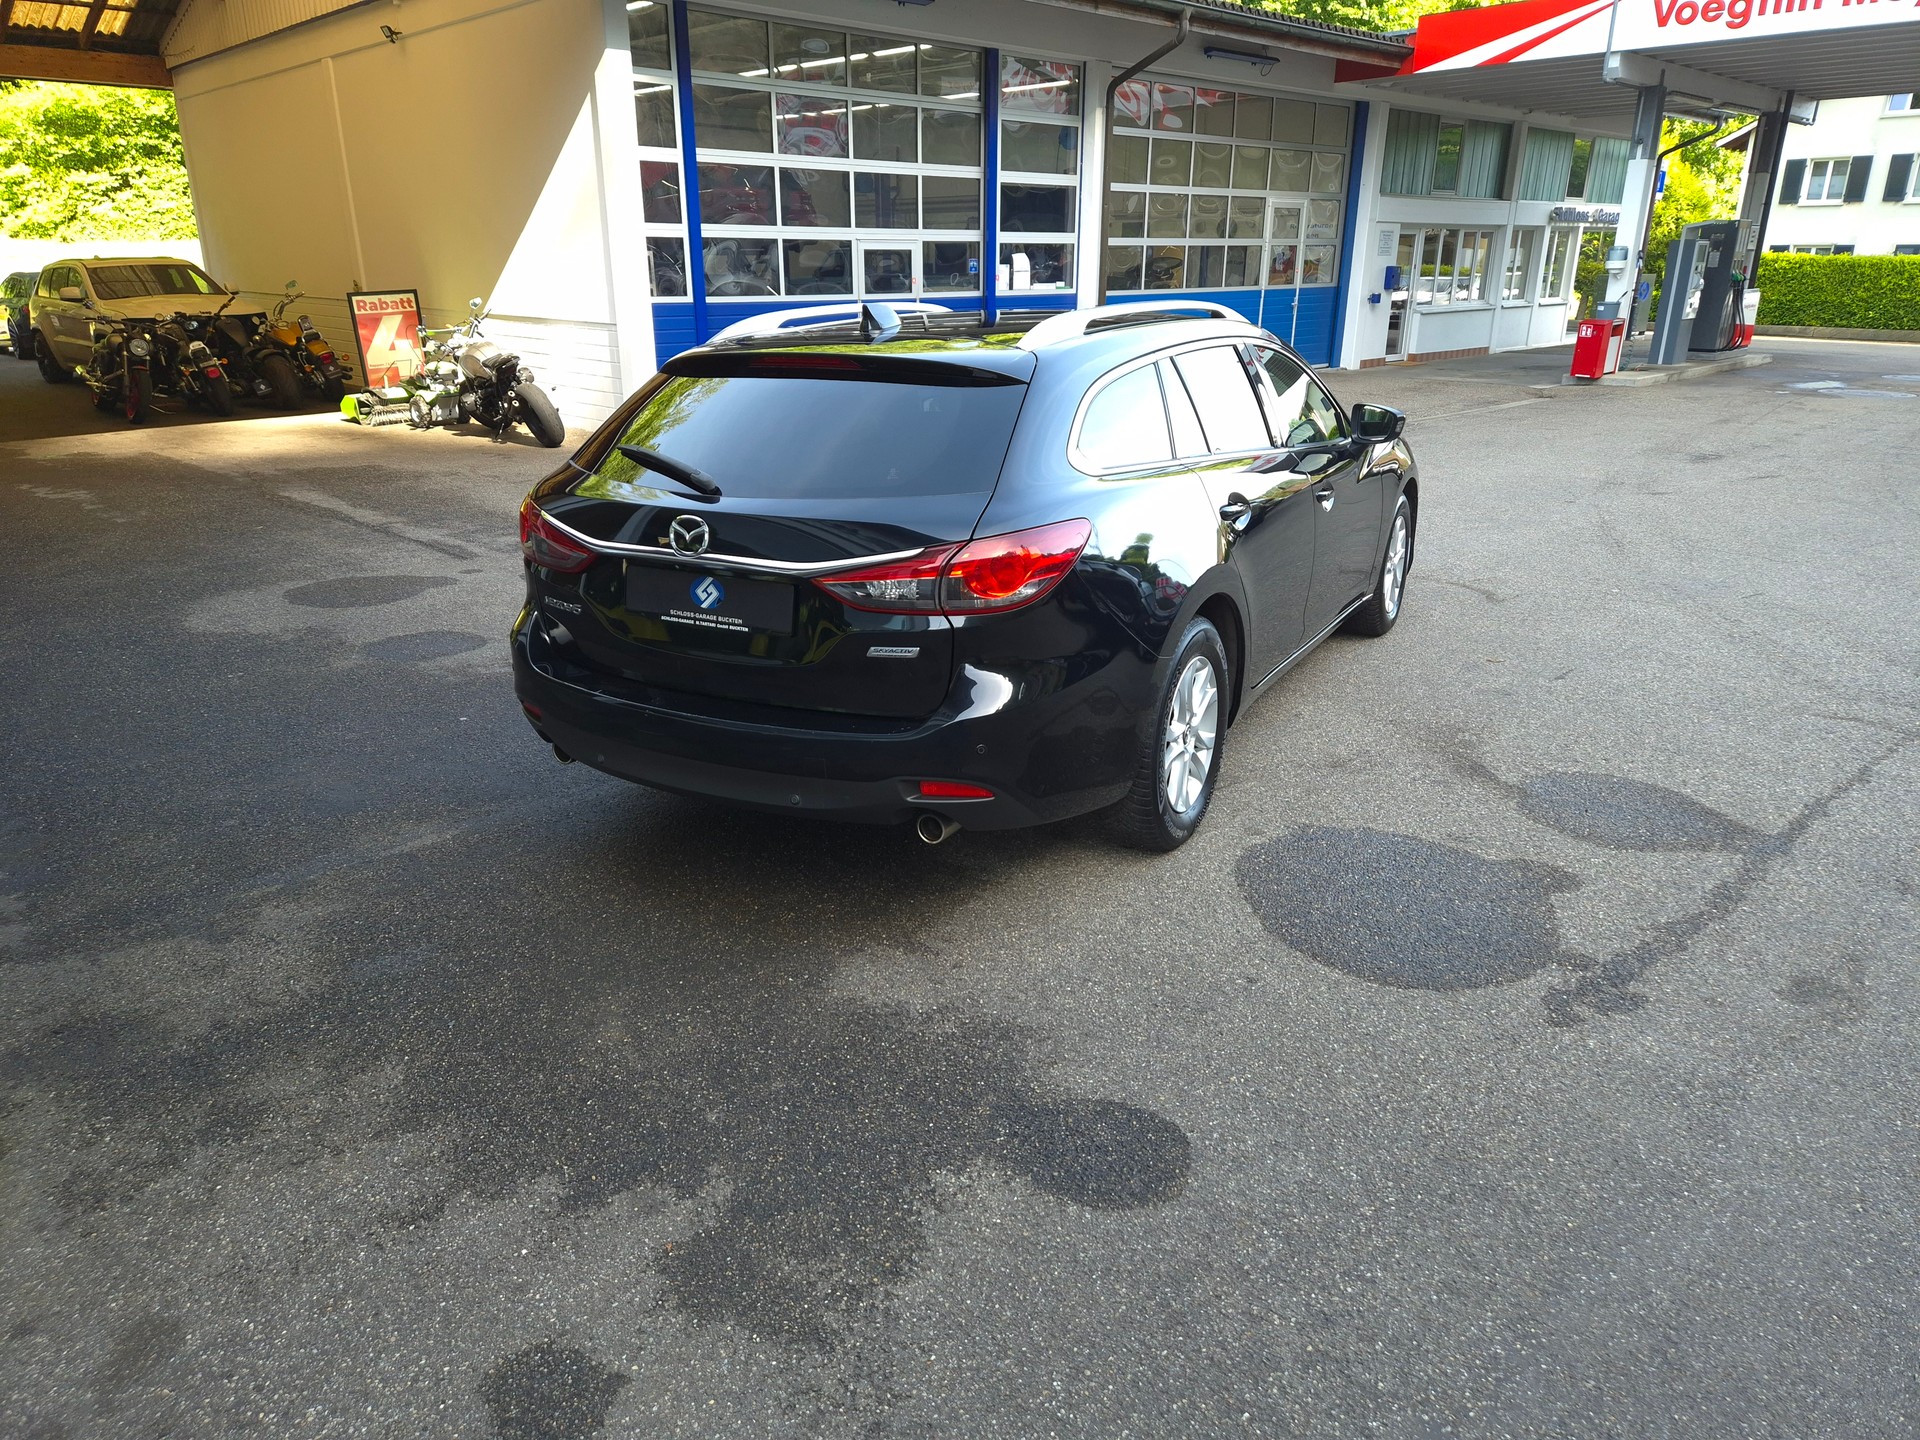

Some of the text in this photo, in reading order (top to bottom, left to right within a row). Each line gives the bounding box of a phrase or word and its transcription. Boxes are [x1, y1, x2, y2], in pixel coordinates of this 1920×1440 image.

[1592, 208, 1621, 225] Garag
[355, 297, 415, 313] Rabatt
[366, 314, 423, 379] 4
[661, 615, 695, 625] SCHLOSS-GARAGE
[669, 609, 743, 625] SCHLOSS-GARAGE BUCKTEN
